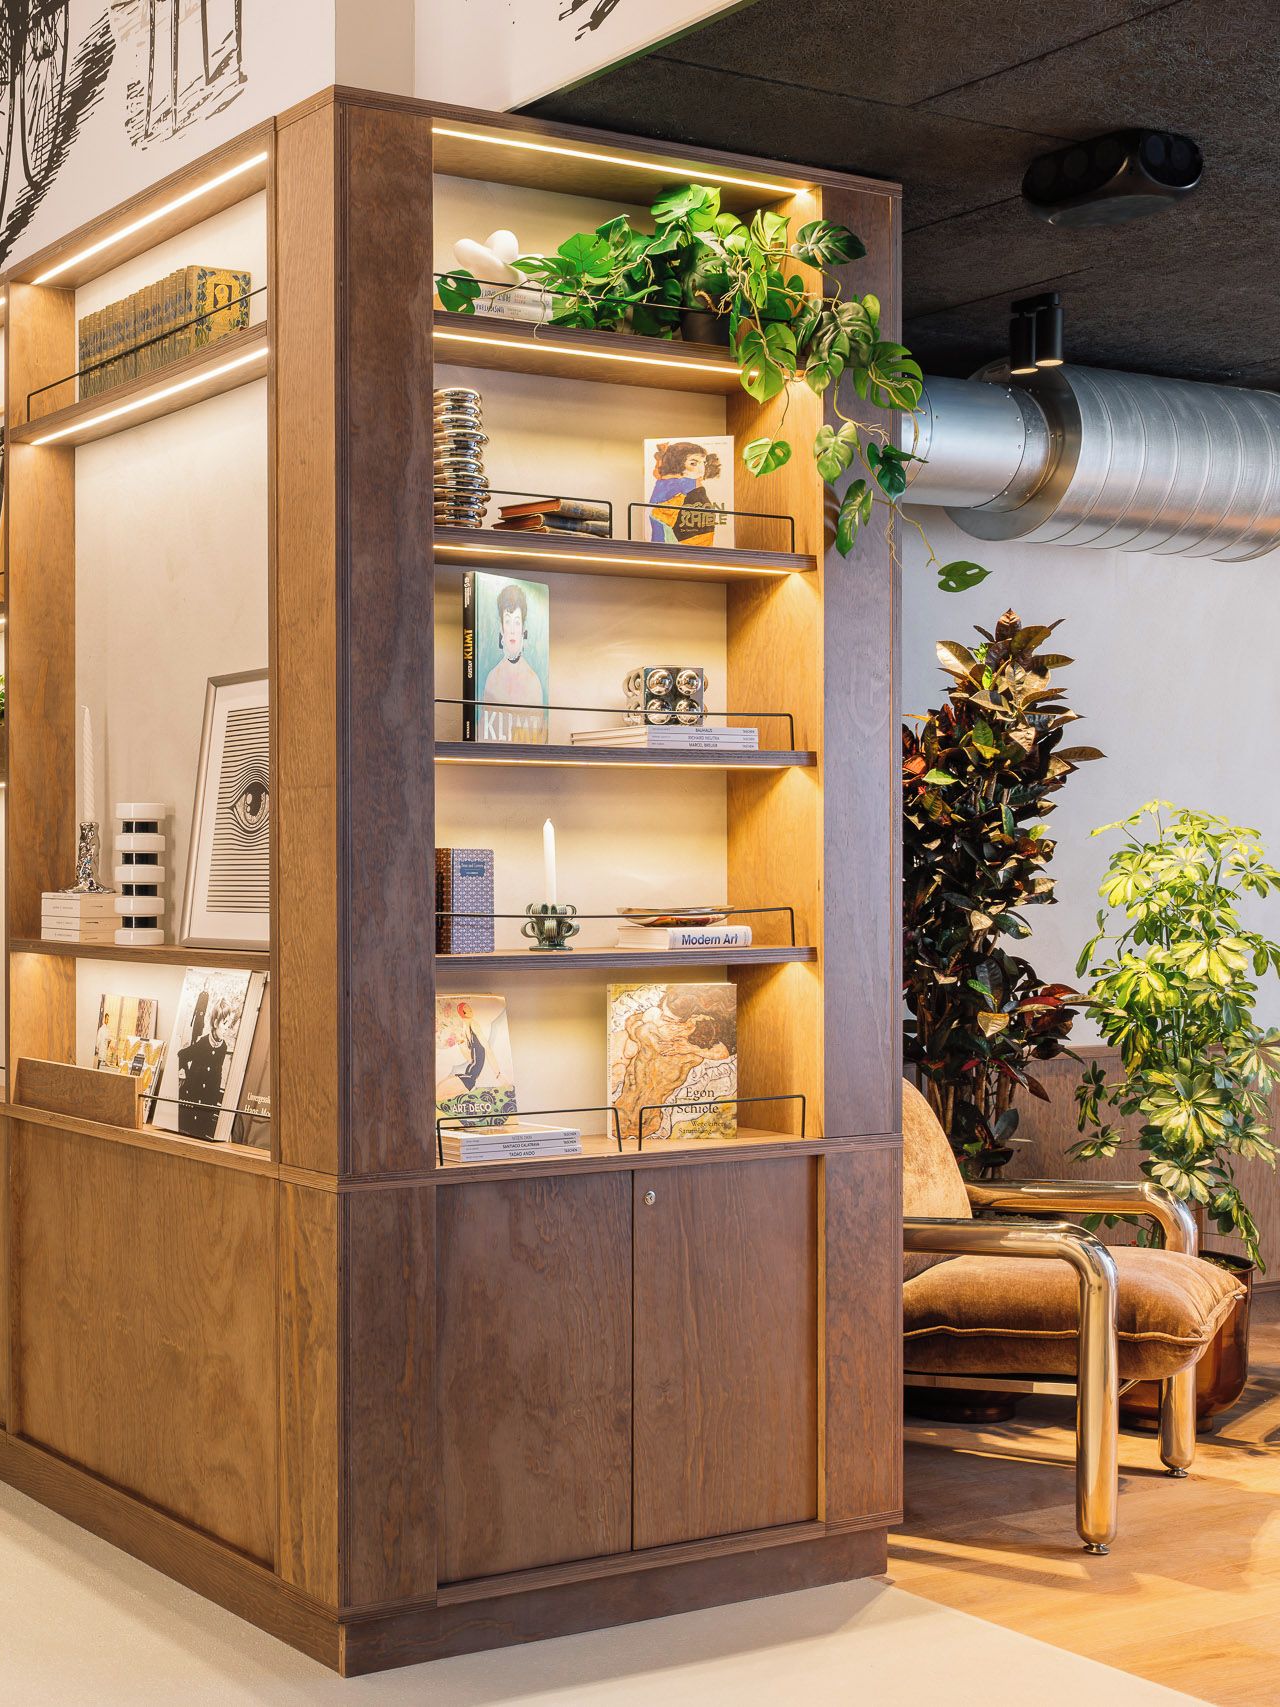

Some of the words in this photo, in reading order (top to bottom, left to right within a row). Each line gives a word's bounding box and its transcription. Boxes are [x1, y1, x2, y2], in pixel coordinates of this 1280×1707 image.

[464, 628, 474, 661] KLIMT
[483, 710, 544, 744] KLIMT
[681, 934, 721, 946] Modern
[722, 933, 738, 945] Art
[685, 1087, 715, 1102] Egon
[451, 1103, 467, 1113] ART
[467, 1103, 492, 1113] DECO
[676, 1103, 719, 1114] Schiele
